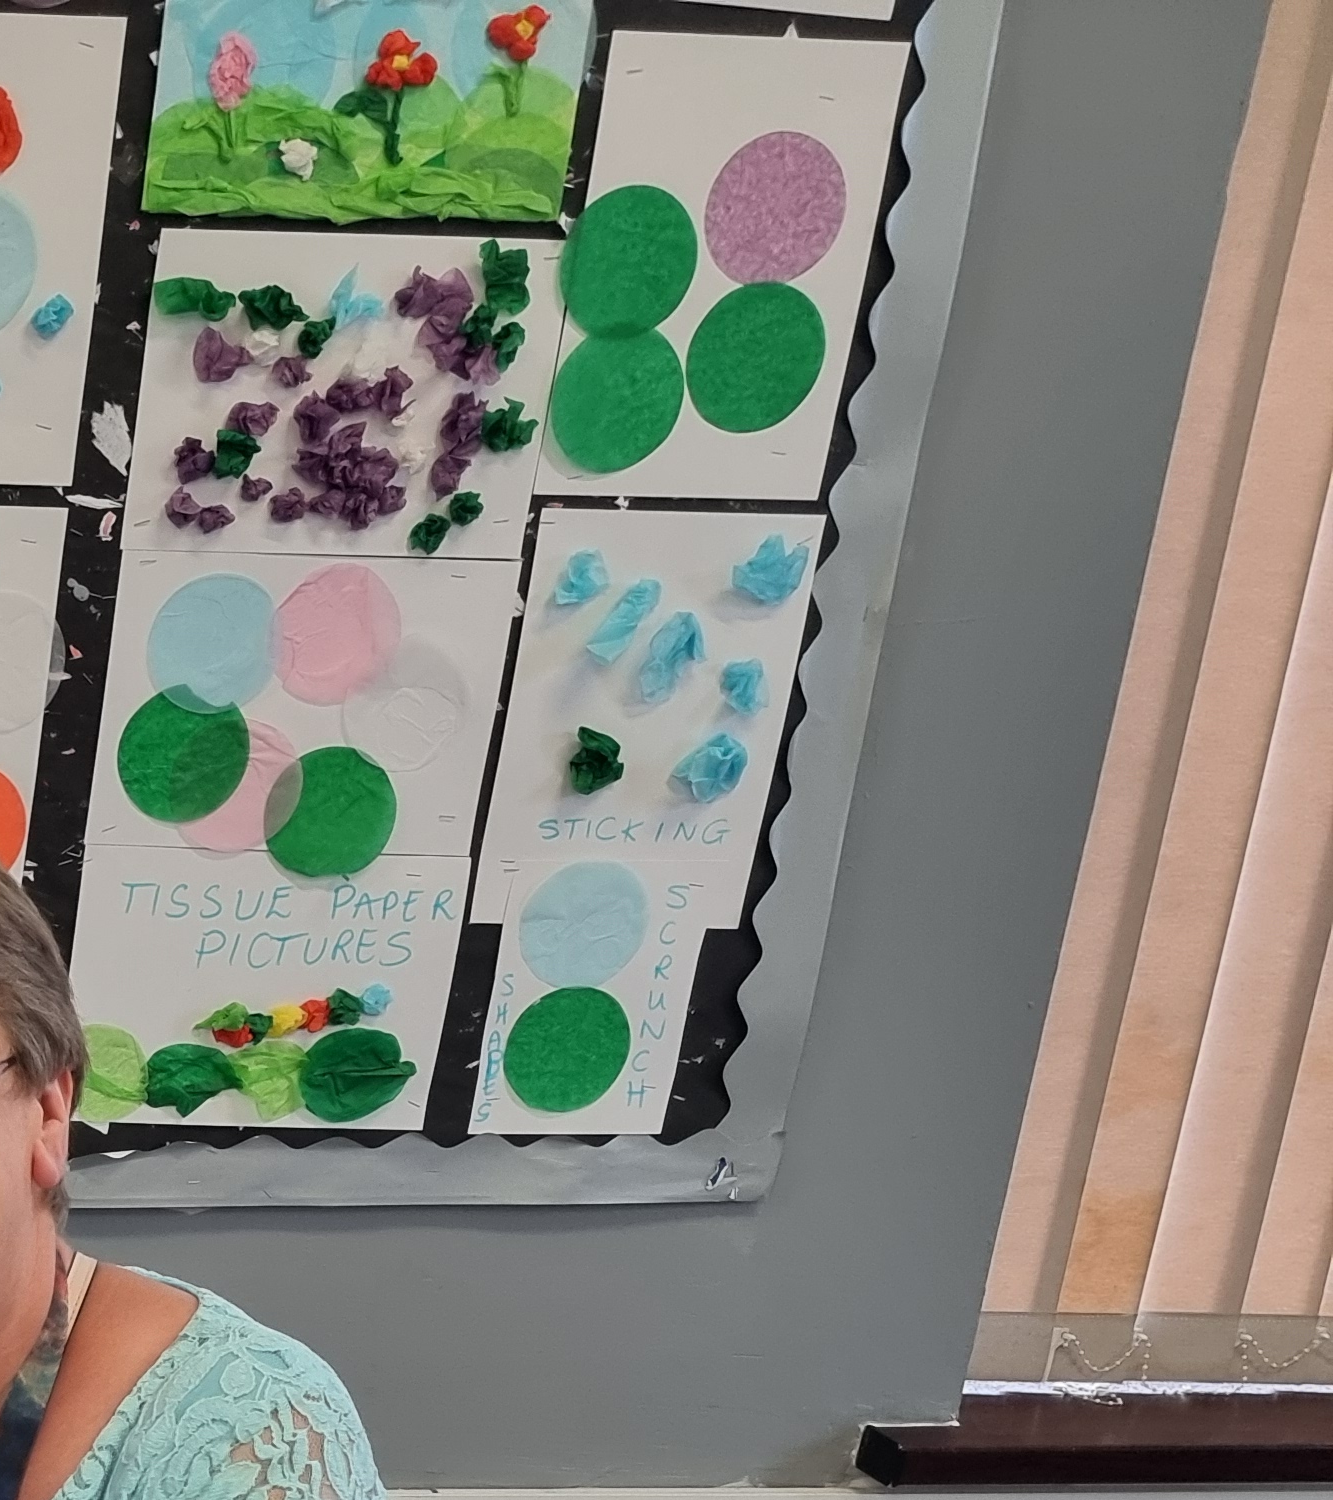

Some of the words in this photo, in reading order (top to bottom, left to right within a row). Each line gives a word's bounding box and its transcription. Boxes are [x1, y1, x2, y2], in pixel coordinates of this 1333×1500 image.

[537, 816, 732, 847] STICKING
[120, 881, 294, 920] TISSUE
[331, 883, 457, 924] PAPER
[194, 928, 418, 971] PICTURES
